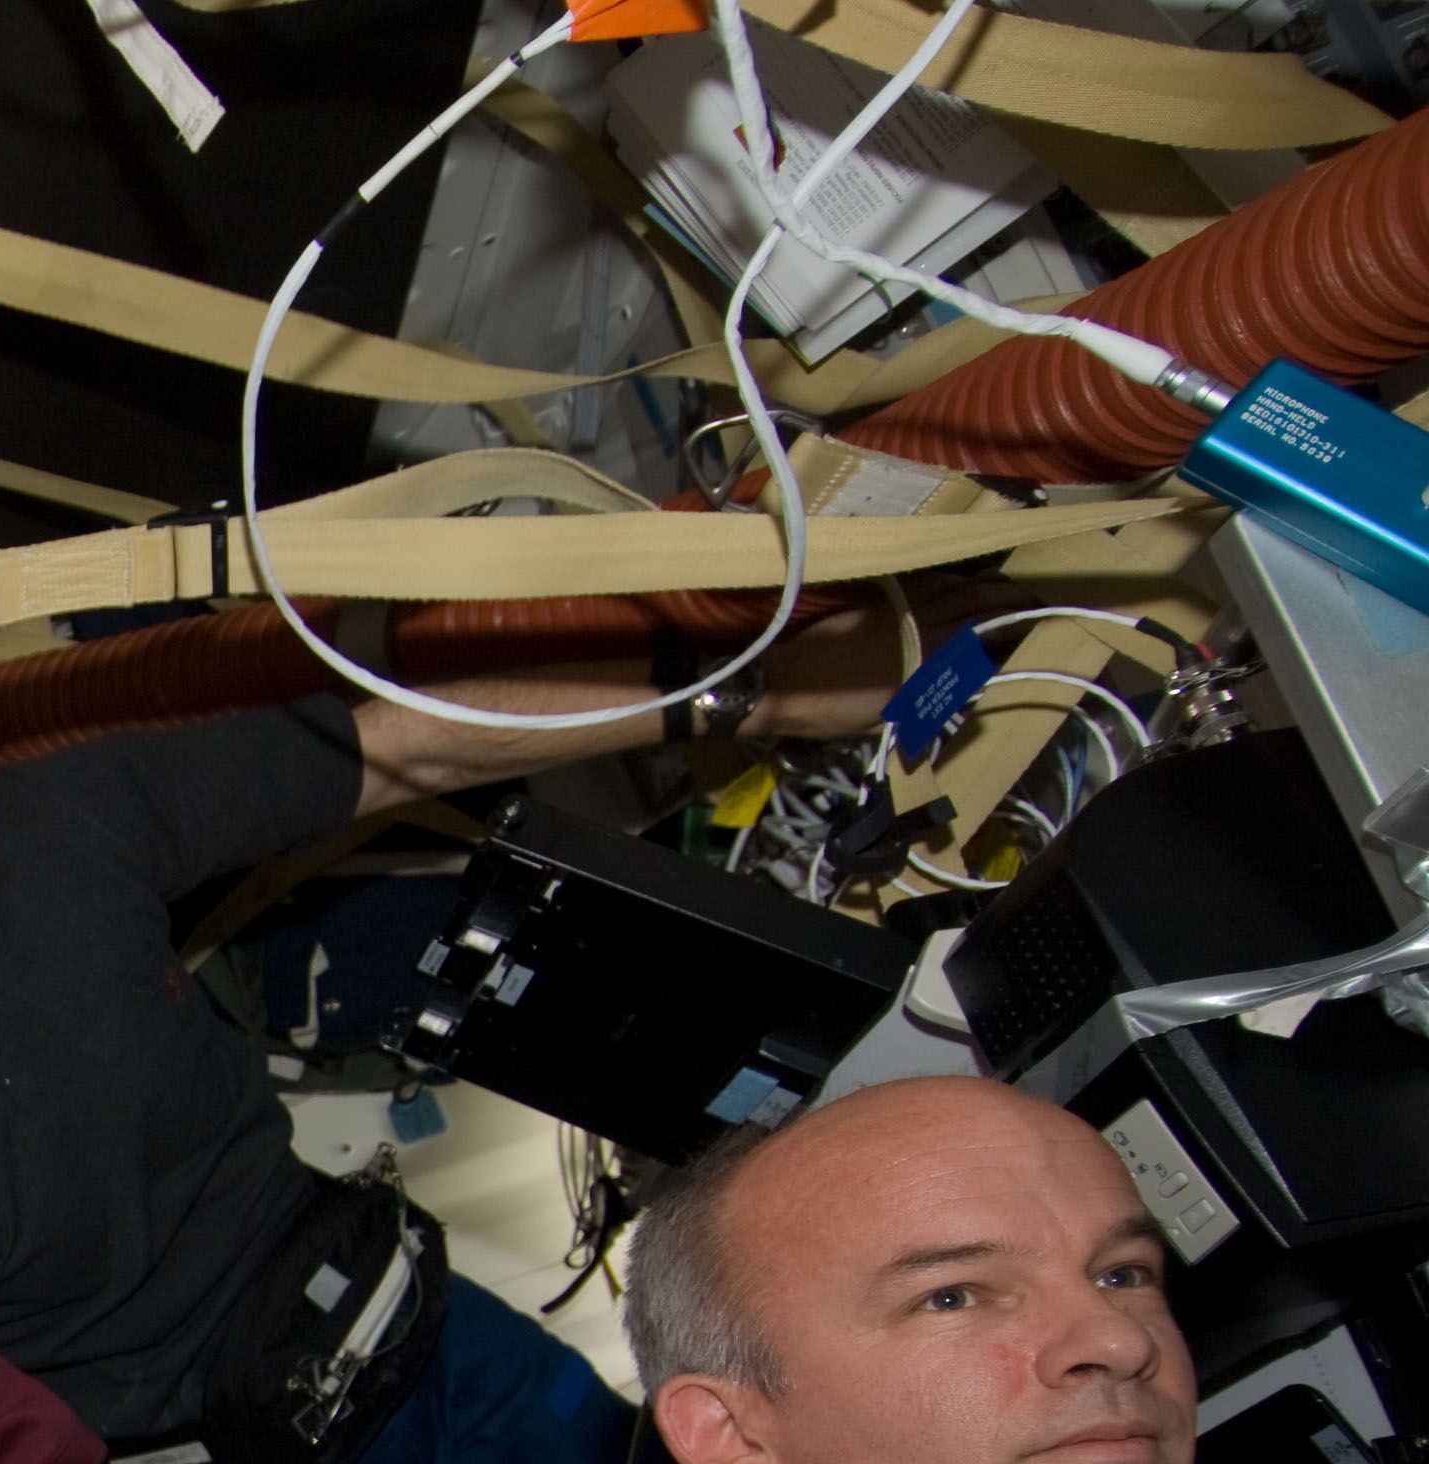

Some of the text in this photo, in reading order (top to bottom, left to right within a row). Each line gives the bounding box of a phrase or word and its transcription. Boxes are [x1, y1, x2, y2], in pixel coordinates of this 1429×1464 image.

[1255, 394, 1316, 430] HAND-HELD
[1263, 385, 1329, 424] MICROPHONE
[1239, 410, 1277, 436] SERIAL
[930, 673, 958, 705] PRINTER
